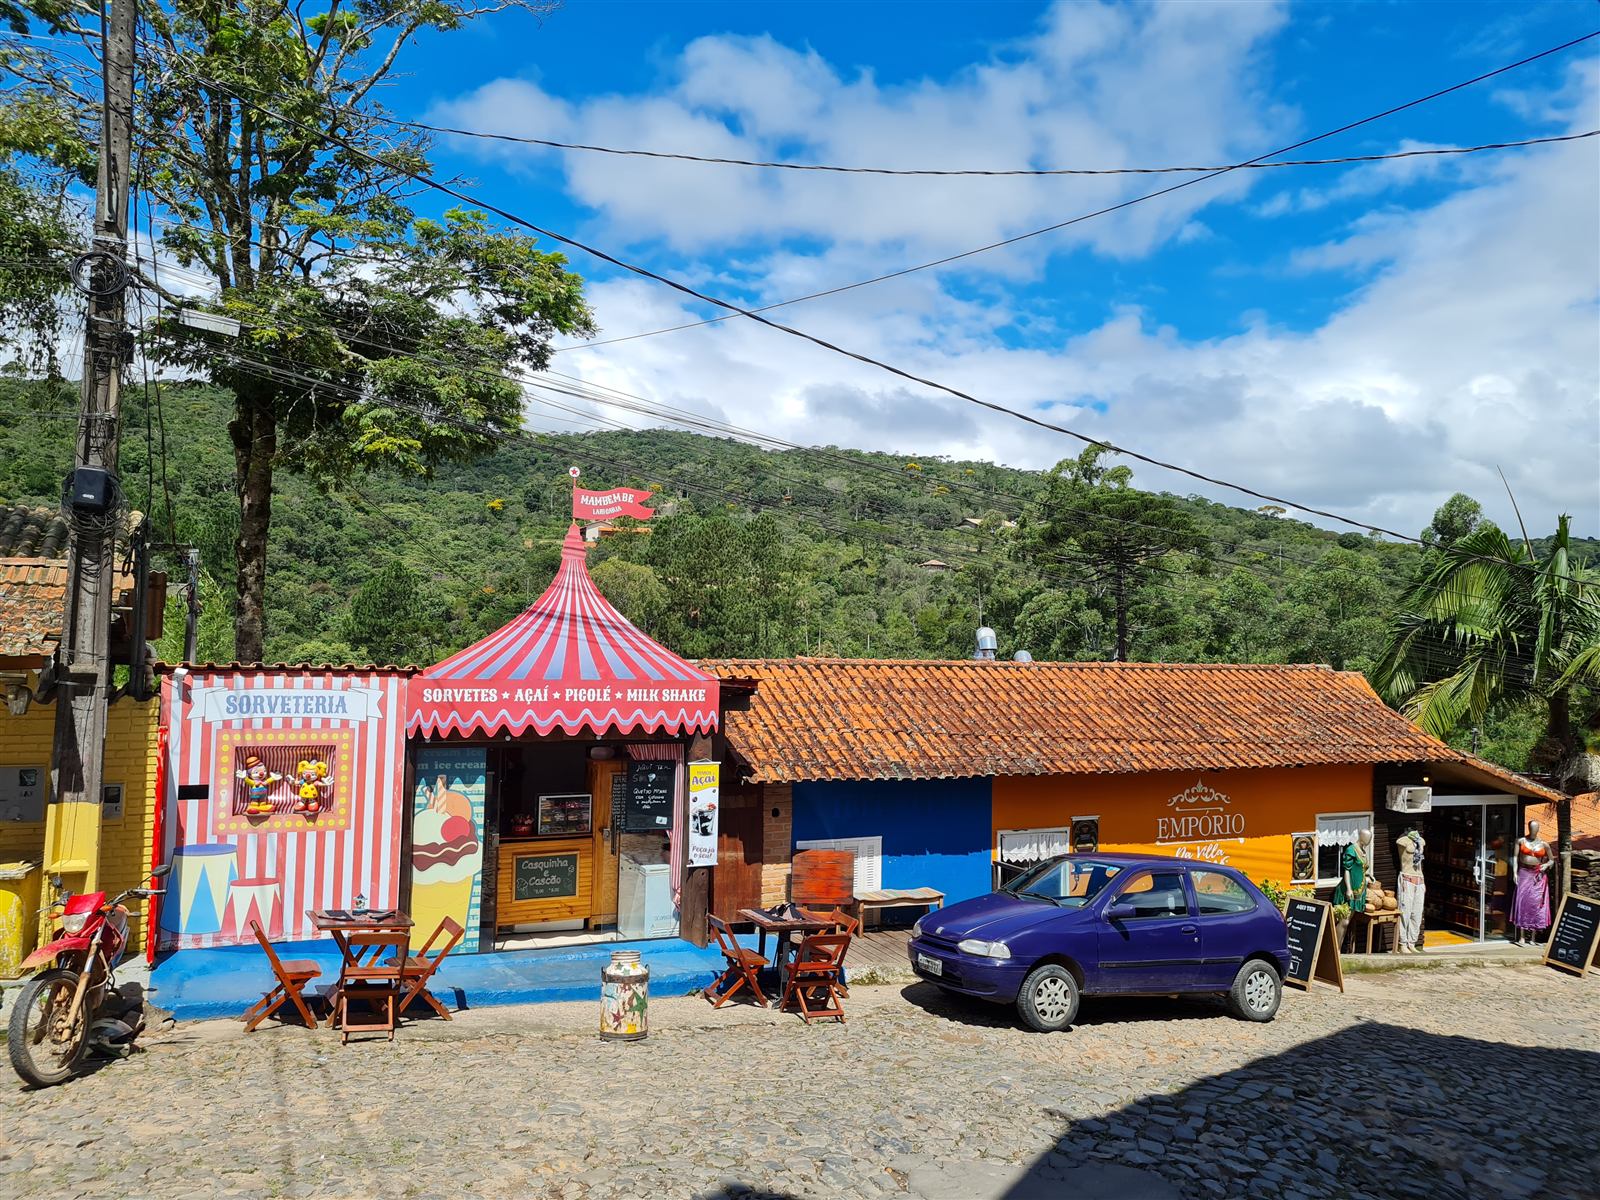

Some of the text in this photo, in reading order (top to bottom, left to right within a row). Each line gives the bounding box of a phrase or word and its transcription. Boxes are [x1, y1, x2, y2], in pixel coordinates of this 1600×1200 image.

[423, 685, 706, 705] SORVETES AÇAÍ PICOLÉ MILK SHAKE
[225, 694, 348, 715] SORVETERIA
[434, 760, 451, 769] ice
[1156, 810, 1245, 840] EMPÓRIO
[1196, 843, 1225, 859] Villa
[521, 858, 569, 872] Casquinha
[528, 874, 562, 887] Cascão
[543, 869, 550, 877] e
